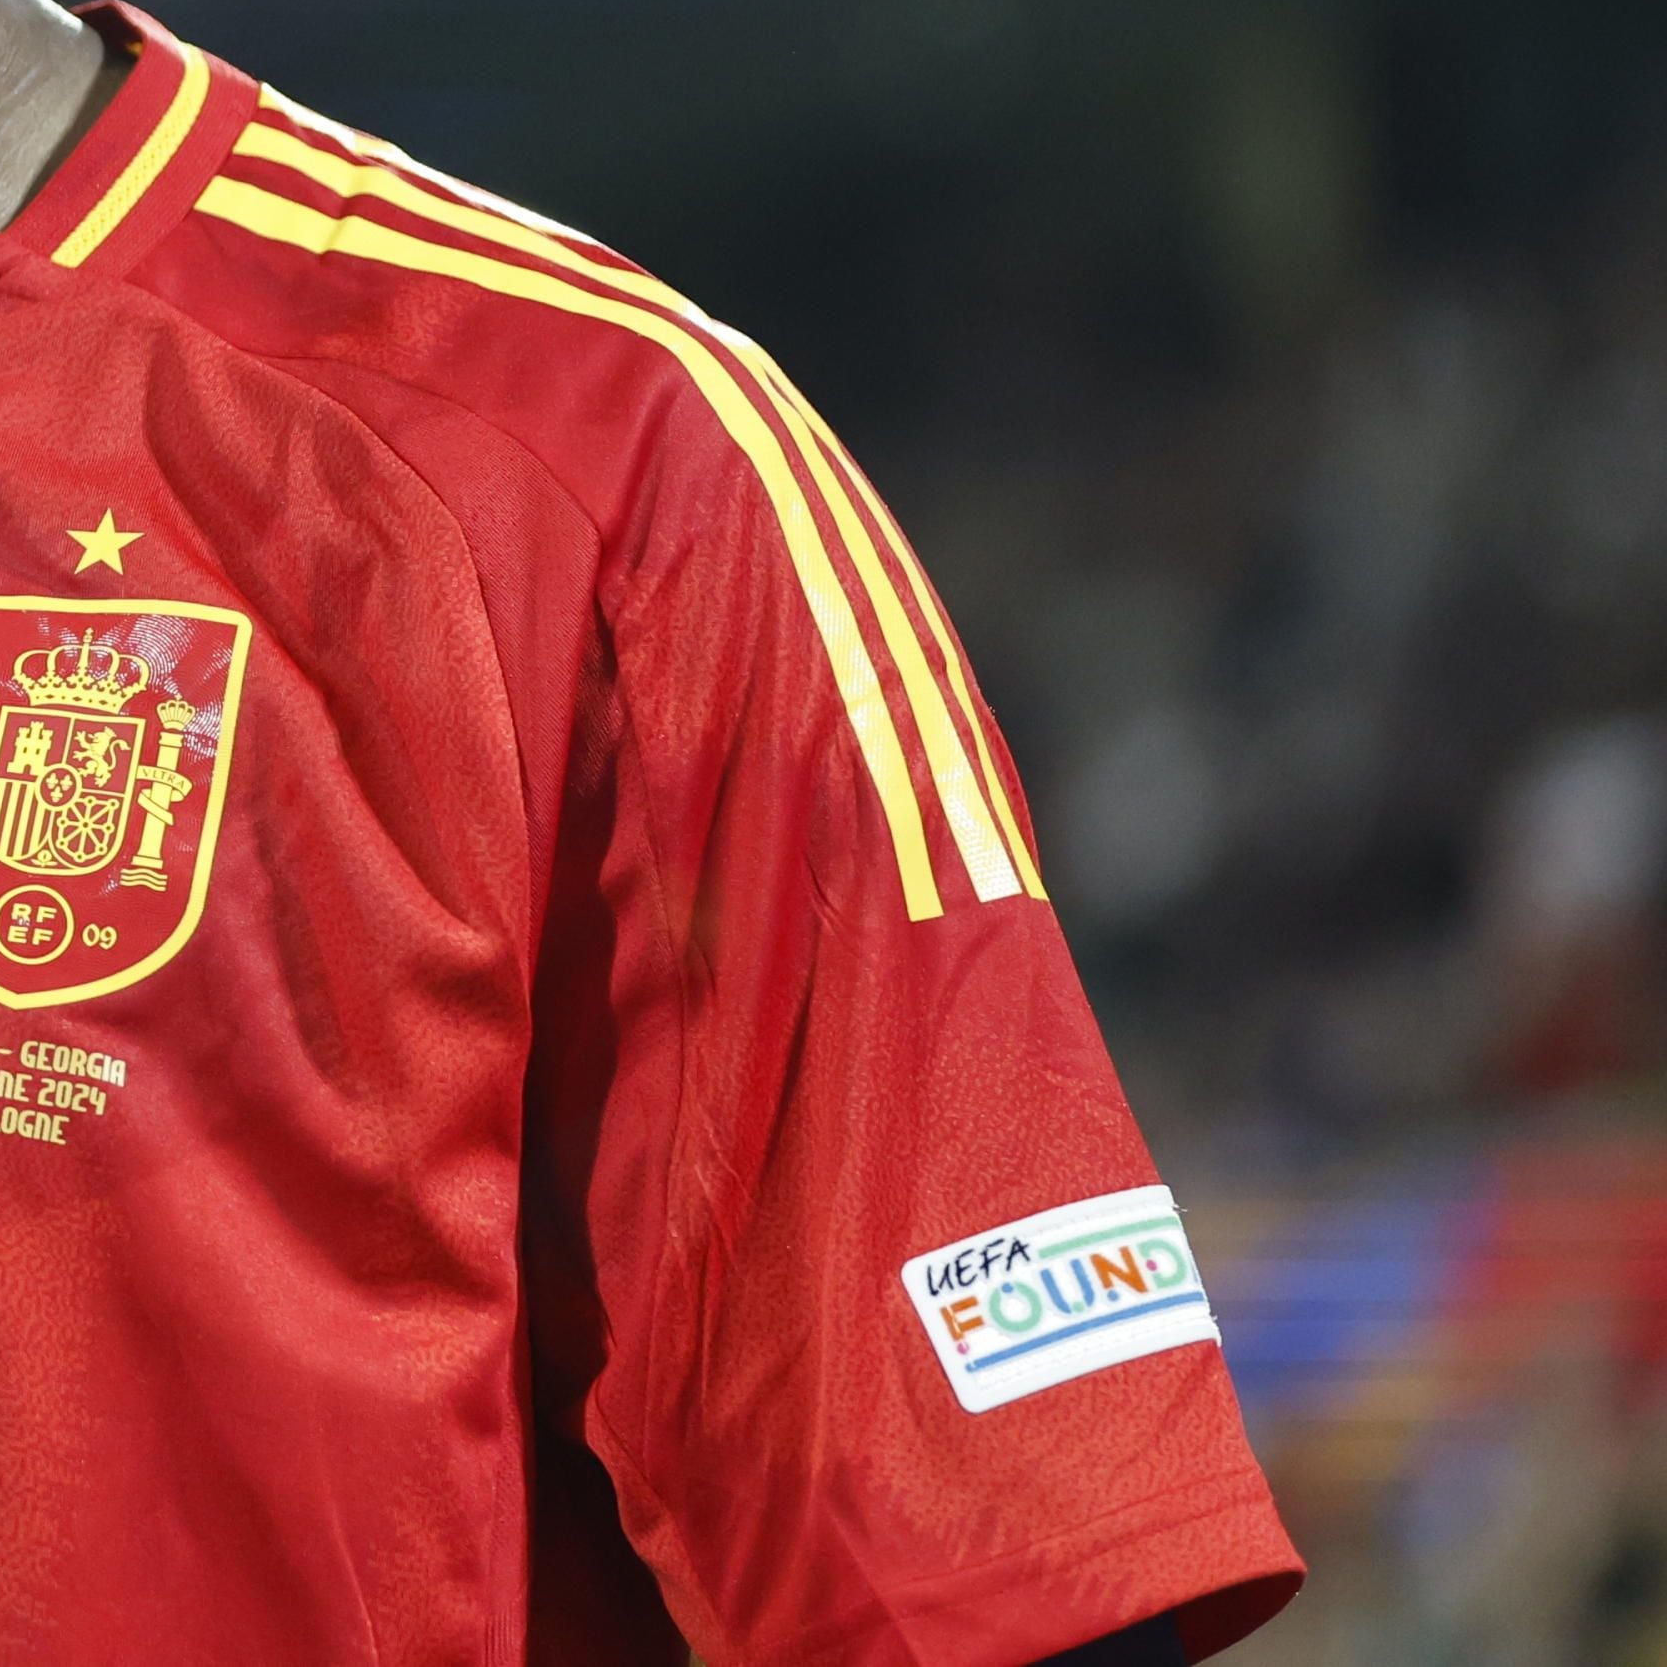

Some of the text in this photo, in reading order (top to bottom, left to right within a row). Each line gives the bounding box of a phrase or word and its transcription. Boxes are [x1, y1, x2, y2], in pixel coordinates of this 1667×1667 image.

[81, 923, 118, 950] 09
[20, 1040, 127, 1088] GEORGIA
[37, 1077, 107, 1116] 2024
[927, 1236, 1031, 1297] UEFA
[940, 1239, 1198, 1352] FOUND
